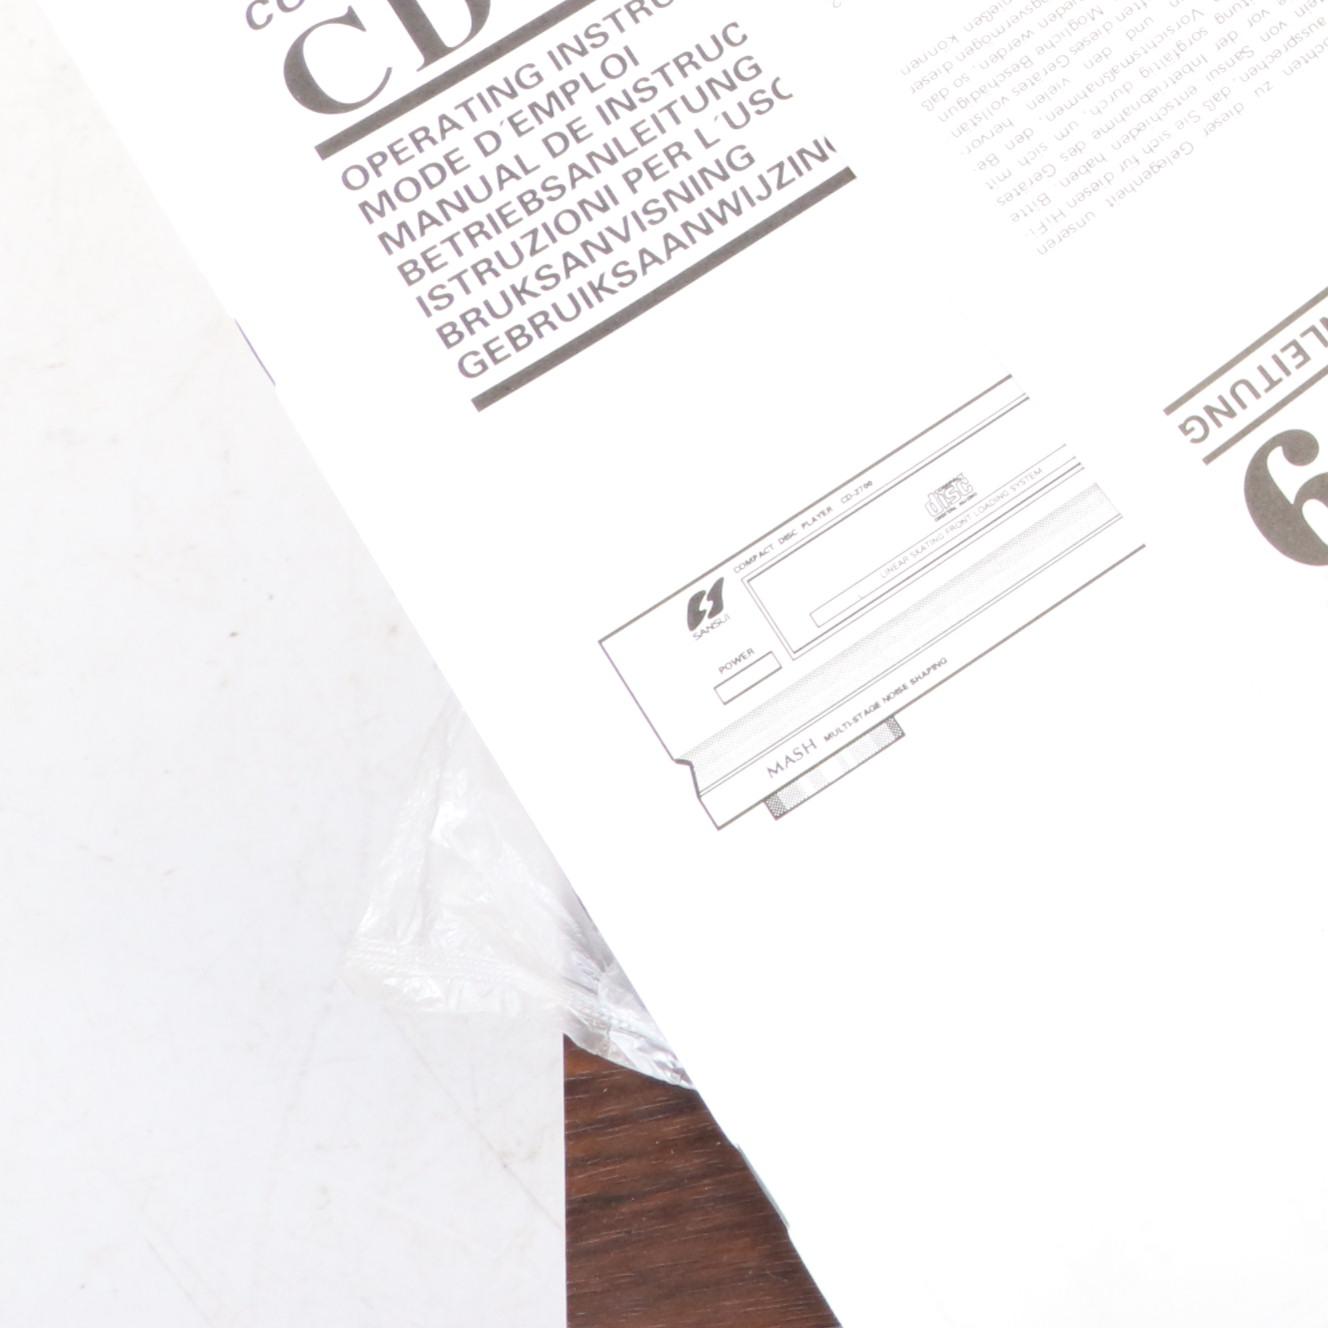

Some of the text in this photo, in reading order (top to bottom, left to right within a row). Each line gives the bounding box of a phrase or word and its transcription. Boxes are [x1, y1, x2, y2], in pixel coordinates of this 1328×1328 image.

[340, 61, 545, 191] OPERATING
[356, 146, 471, 225] MODE
[376, 152, 541, 256] MANUAL
[540, 115, 594, 159] DE
[395, 54, 763, 287] BETRIEBSANLEITUNG
[414, 183, 620, 318] ISTRUZIONI
[620, 140, 693, 195] PER
[434, 143, 756, 350] BRUKSANVISNING
[456, 135, 837, 379] GEBRUIKSAANWIJZIN
[717, 646, 755, 674] POWER
[765, 737, 817, 778] MASH
